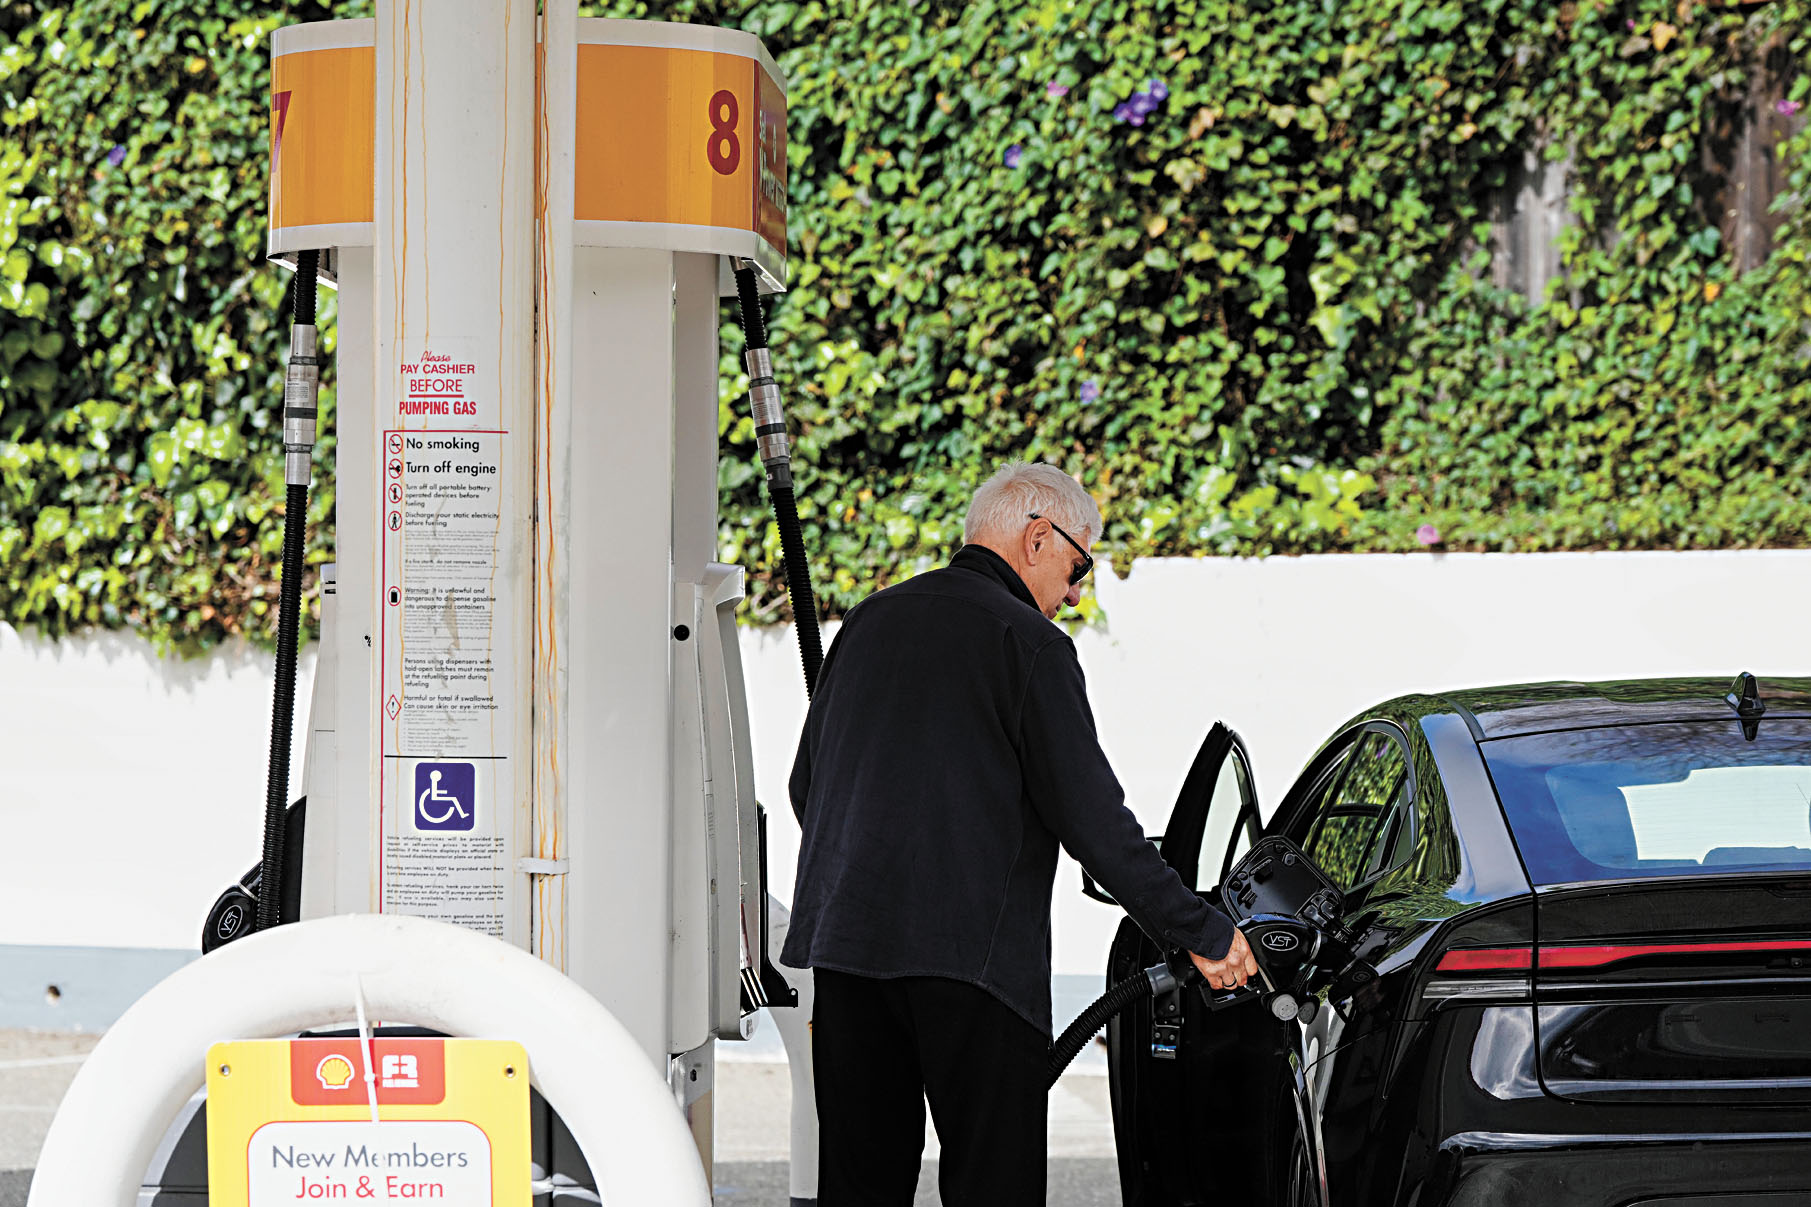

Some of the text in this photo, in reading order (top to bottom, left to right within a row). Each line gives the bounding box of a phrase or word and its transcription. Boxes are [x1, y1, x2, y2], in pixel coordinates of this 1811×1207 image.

[272, 91, 292, 173] 7
[707, 90, 740, 175] 8
[421, 351, 451, 362] Please
[401, 365, 475, 374] PAY CASHIER
[410, 379, 462, 392] BEFORE
[399, 401, 477, 415] PUMPING GAS
[406, 437, 480, 453] No smoking
[406, 461, 497, 477] Turn off engine
[419, 483, 428, 491] off
[439, 484, 466, 493] portable
[405, 512, 435, 520] Discharge
[471, 513, 499, 521] electricity
[427, 658, 444, 666] using
[445, 658, 478, 667] dispensers
[422, 673, 448, 681] refueling
[468, 674, 488, 682] during
[404, 681, 430, 689] refueling
[461, 695, 494, 703] swallowed
[473, 703, 499, 711] irritation
[221, 911, 238, 933] VST
[1269, 935, 1291, 947] VST
[272, 1143, 468, 1168] New Members
[296, 1176, 444, 1199] Join & Earn
